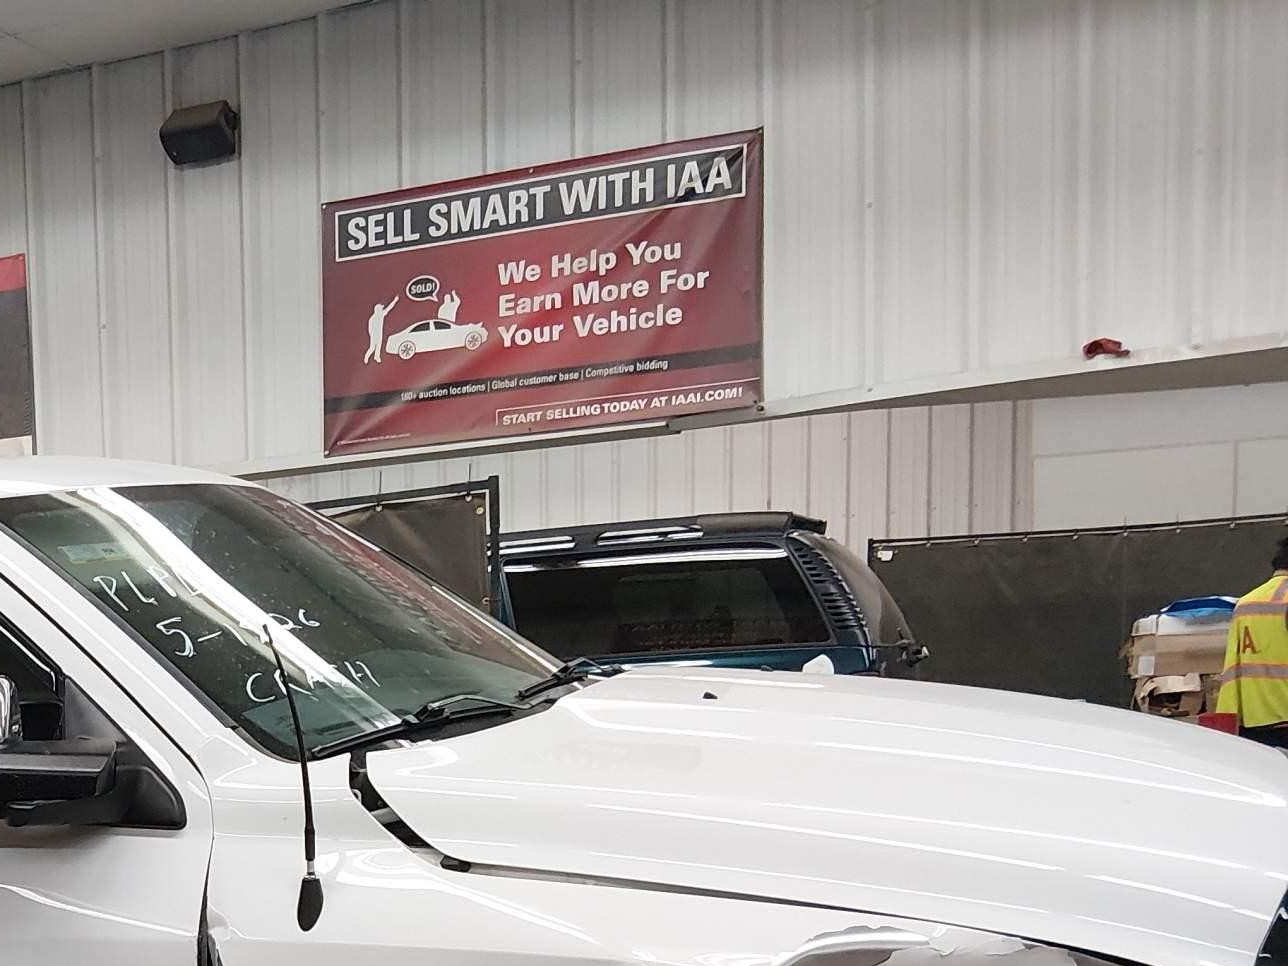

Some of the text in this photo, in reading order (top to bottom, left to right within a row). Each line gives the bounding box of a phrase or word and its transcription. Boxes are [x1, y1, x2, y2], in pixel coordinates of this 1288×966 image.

[346, 157, 733, 251] SELL SMART WITH IAA
[497, 240, 682, 286] We Help You
[410, 282, 436, 295] SOLD!
[498, 268, 711, 317] Earn More For
[497, 303, 683, 348] Your Vehicle
[418, 388, 449, 400] auction
[449, 383, 486, 396] locations
[491, 377, 518, 390] Global
[518, 374, 557, 387] customer
[558, 370, 579, 381] base
[585, 362, 635, 378] Competitive
[636, 359, 669, 371] bidding
[502, 387, 743, 426] START SELLING TODAY AT IAAI.COM!
